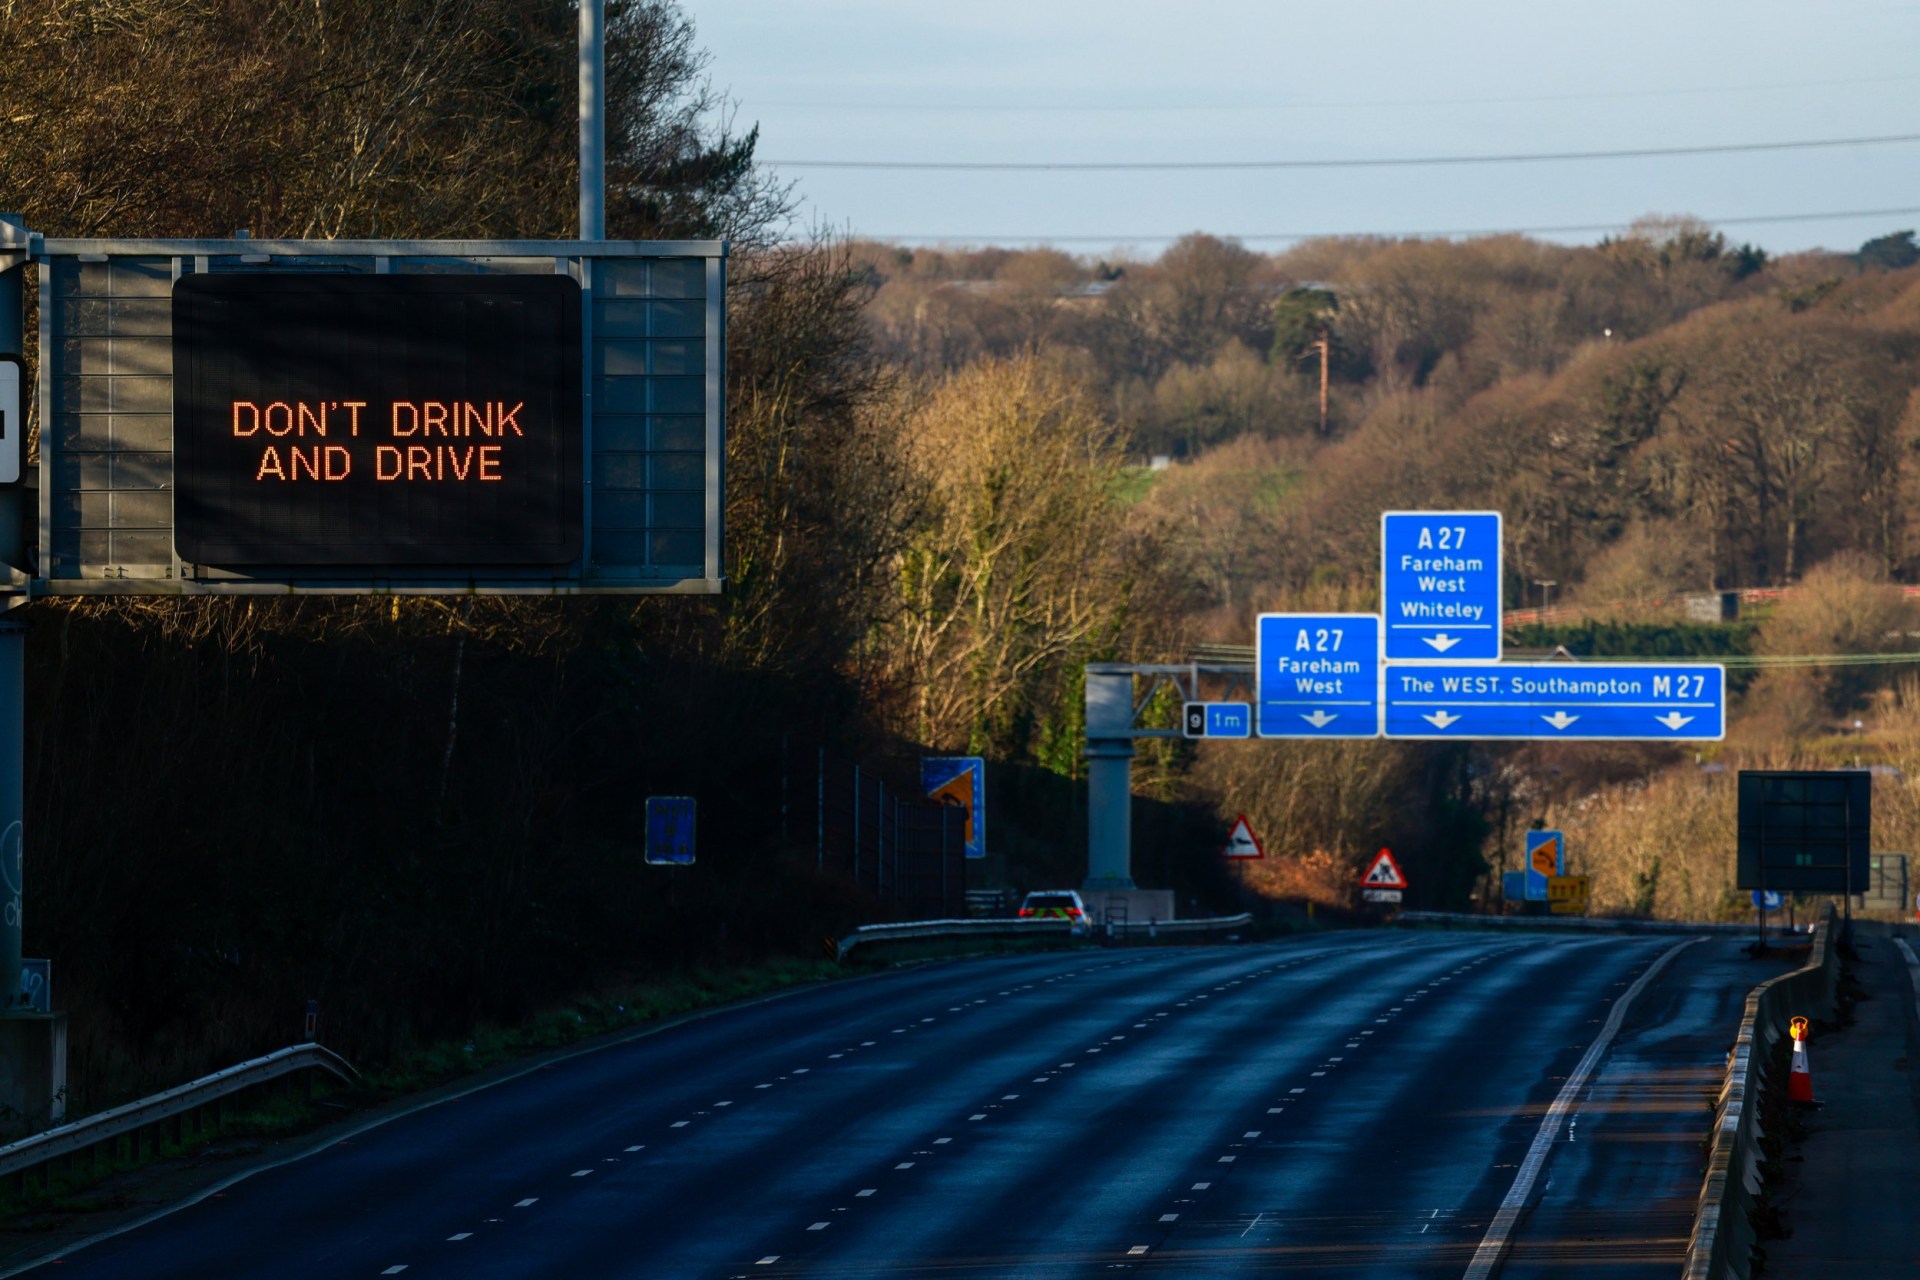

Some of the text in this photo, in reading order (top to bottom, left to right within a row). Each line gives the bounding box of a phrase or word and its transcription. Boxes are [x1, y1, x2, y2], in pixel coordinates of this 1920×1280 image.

[233, 401, 524, 437] DON'T DRINK
[256, 445, 502, 481] AND DRIVE
[1401, 555, 1483, 571] Fareham
[1418, 576, 1466, 592] West
[1400, 601, 1483, 620] Whiteley
[1279, 657, 1360, 673] Fareham
[1296, 678, 1343, 694] West
[1402, 676, 1434, 693] The
[1511, 676, 1641, 698] Southampton
[1190, 714, 1201, 728] 9
